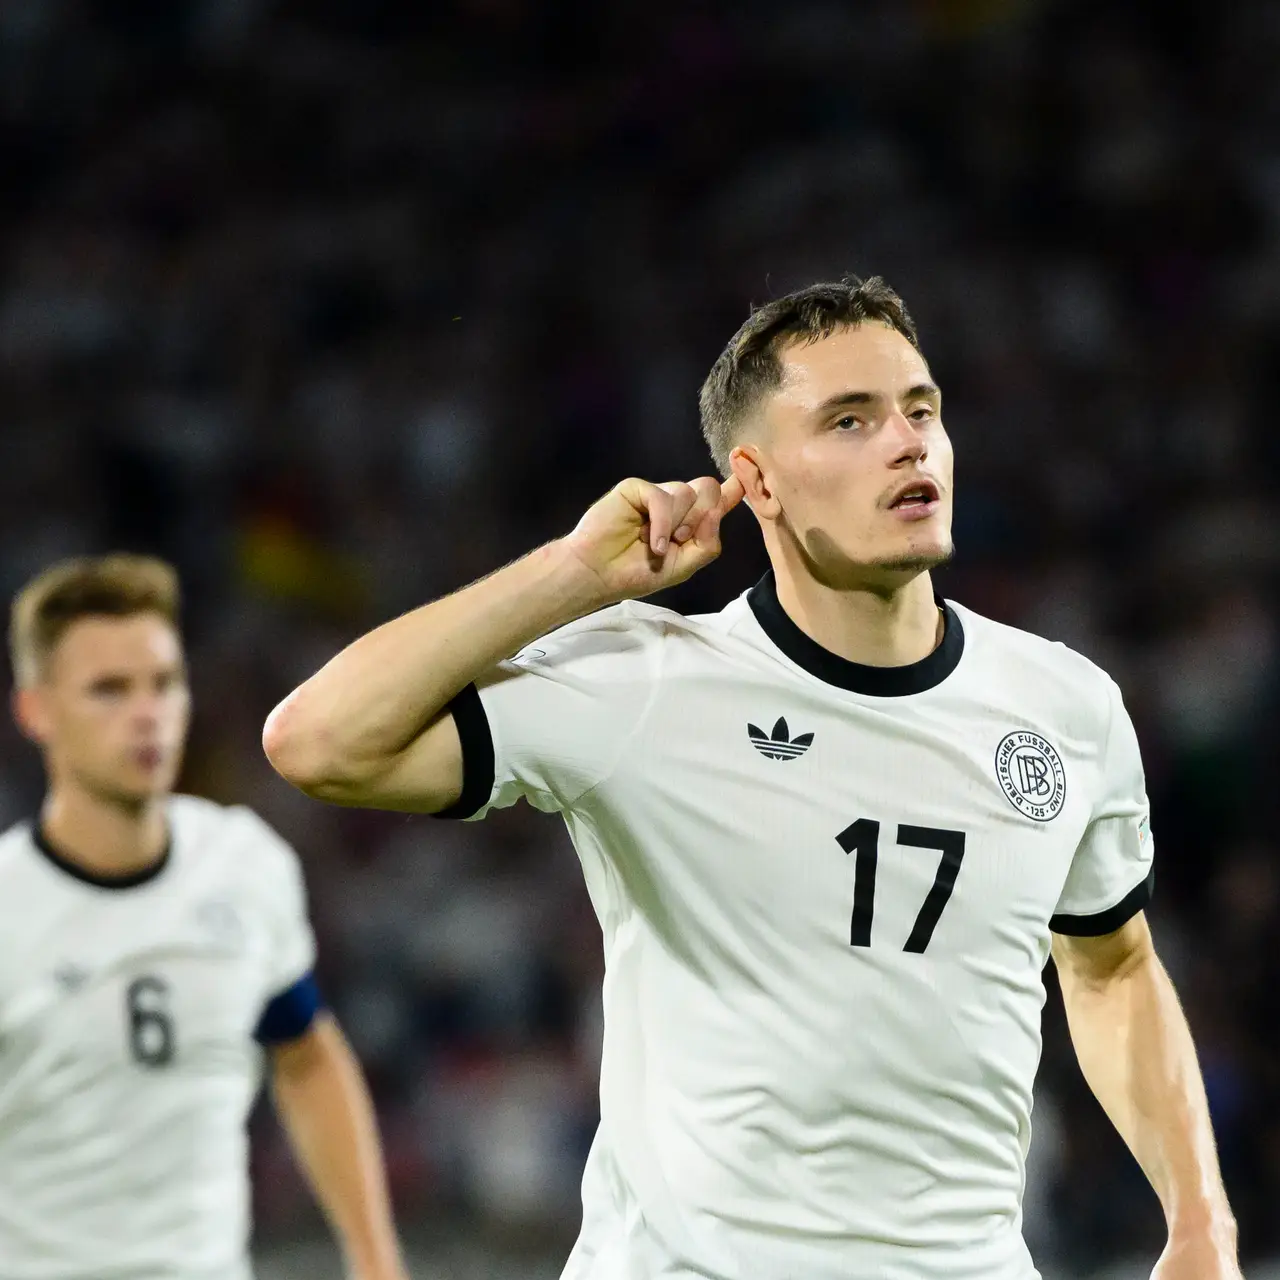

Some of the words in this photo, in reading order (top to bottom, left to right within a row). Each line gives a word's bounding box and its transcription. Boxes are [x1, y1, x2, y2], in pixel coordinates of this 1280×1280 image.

[1030, 806, 1045, 817] 125
[834, 817, 966, 954] 17
[124, 973, 175, 1070] 6
